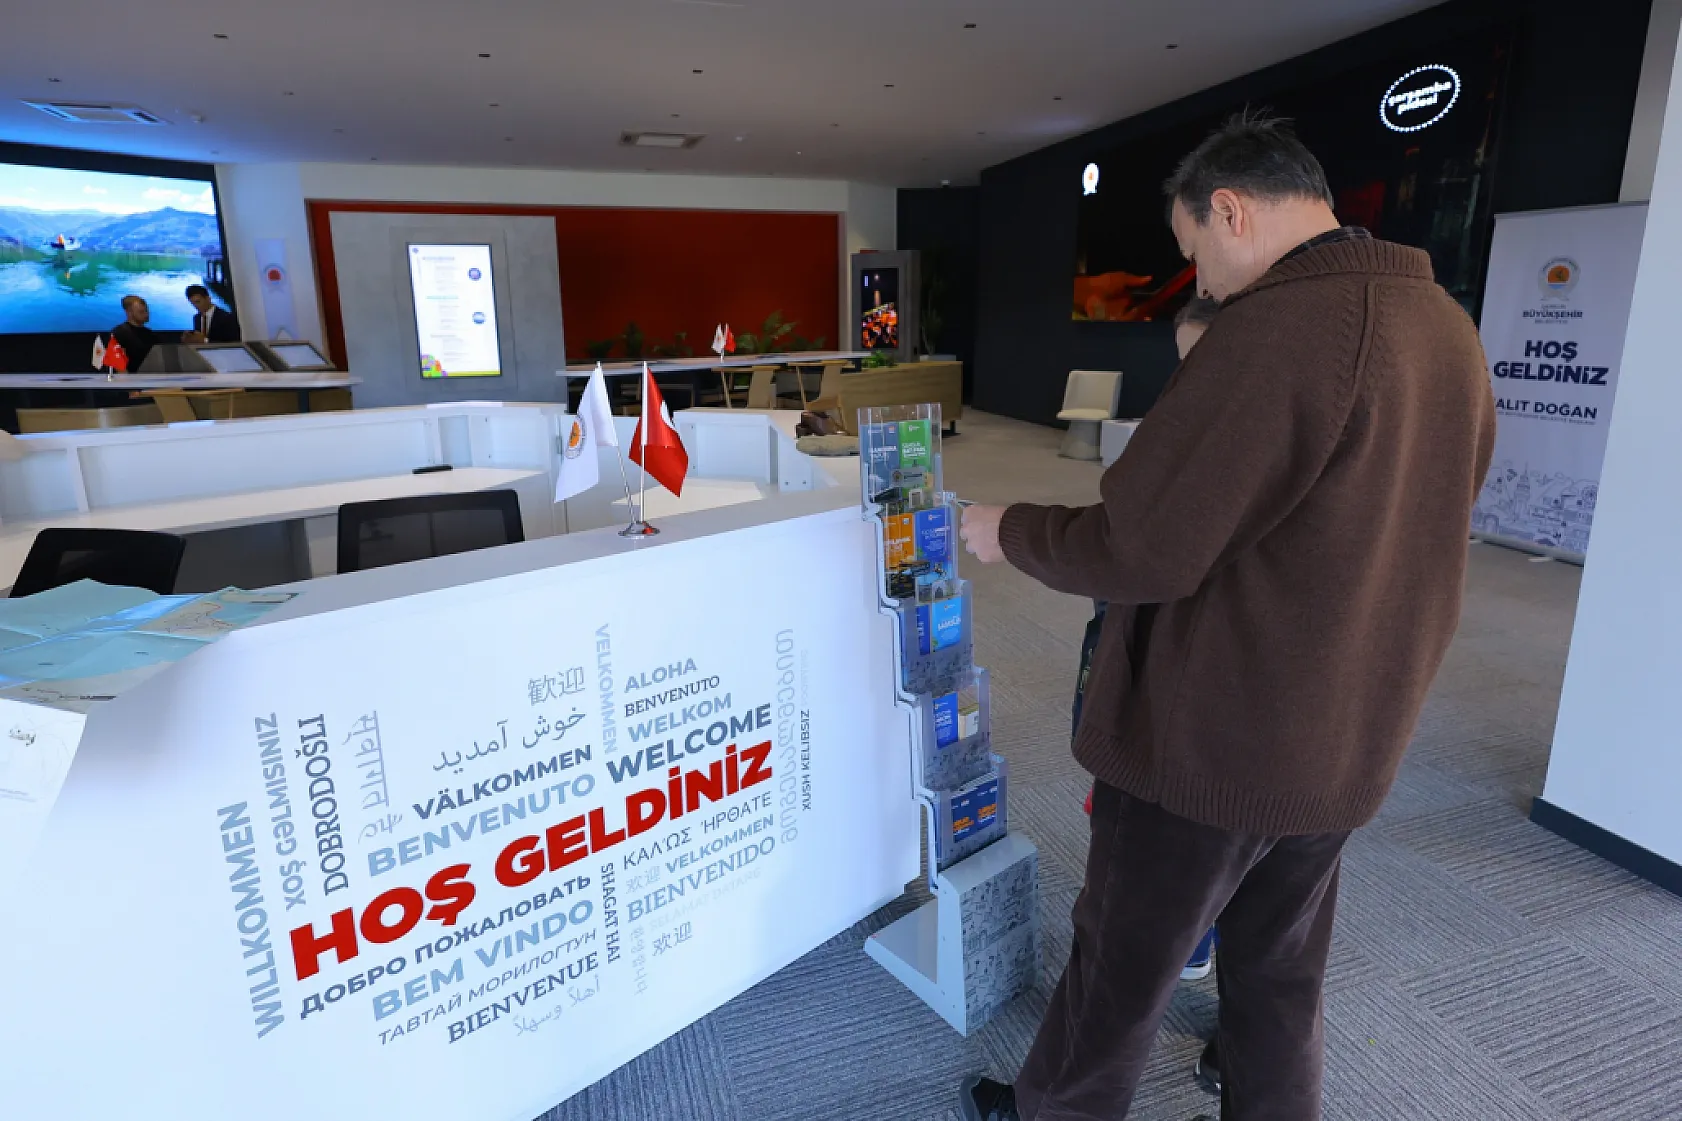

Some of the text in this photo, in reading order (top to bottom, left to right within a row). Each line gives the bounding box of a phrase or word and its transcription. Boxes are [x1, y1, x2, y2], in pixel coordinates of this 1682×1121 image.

[1493, 361, 1610, 386] GELDİNİZ
[1524, 340, 1579, 362] HOŞ
[1534, 401, 1598, 419] DOĞAN
[595, 623, 618, 754] VELKOMMEN
[624, 657, 698, 693] ALOHA
[624, 675, 720, 718] BENVENUTO
[522, 707, 586, 749] خوش
[606, 703, 772, 784] WELCOME
[627, 692, 732, 743] WELKOM
[800, 708, 811, 771] KELIBSIZ
[295, 713, 349, 897] DOBRODOŠLI
[412, 744, 592, 820] VÄLKOMMEN
[801, 774, 812, 812] XUSH
[290, 740, 773, 982] HOŞ GELDİNİZ
[368, 773, 596, 877] BENVENUTO
[665, 814, 774, 873] VELKOMMEN
[280, 859, 307, 911] XOŞ
[601, 862, 621, 964] SHAGAT HAI
[626, 836, 776, 923] BIENVENIDO
[217, 801, 285, 1039] WILLKOMMEN
[299, 876, 591, 1020] ДОБРО ПОЖАЛОВАТЬ
[372, 899, 594, 1021] BEM VINDO
[378, 928, 597, 1046] ТАВТАЙ МОРИЛОГТУН
[447, 951, 599, 1044] BIENVENUE
